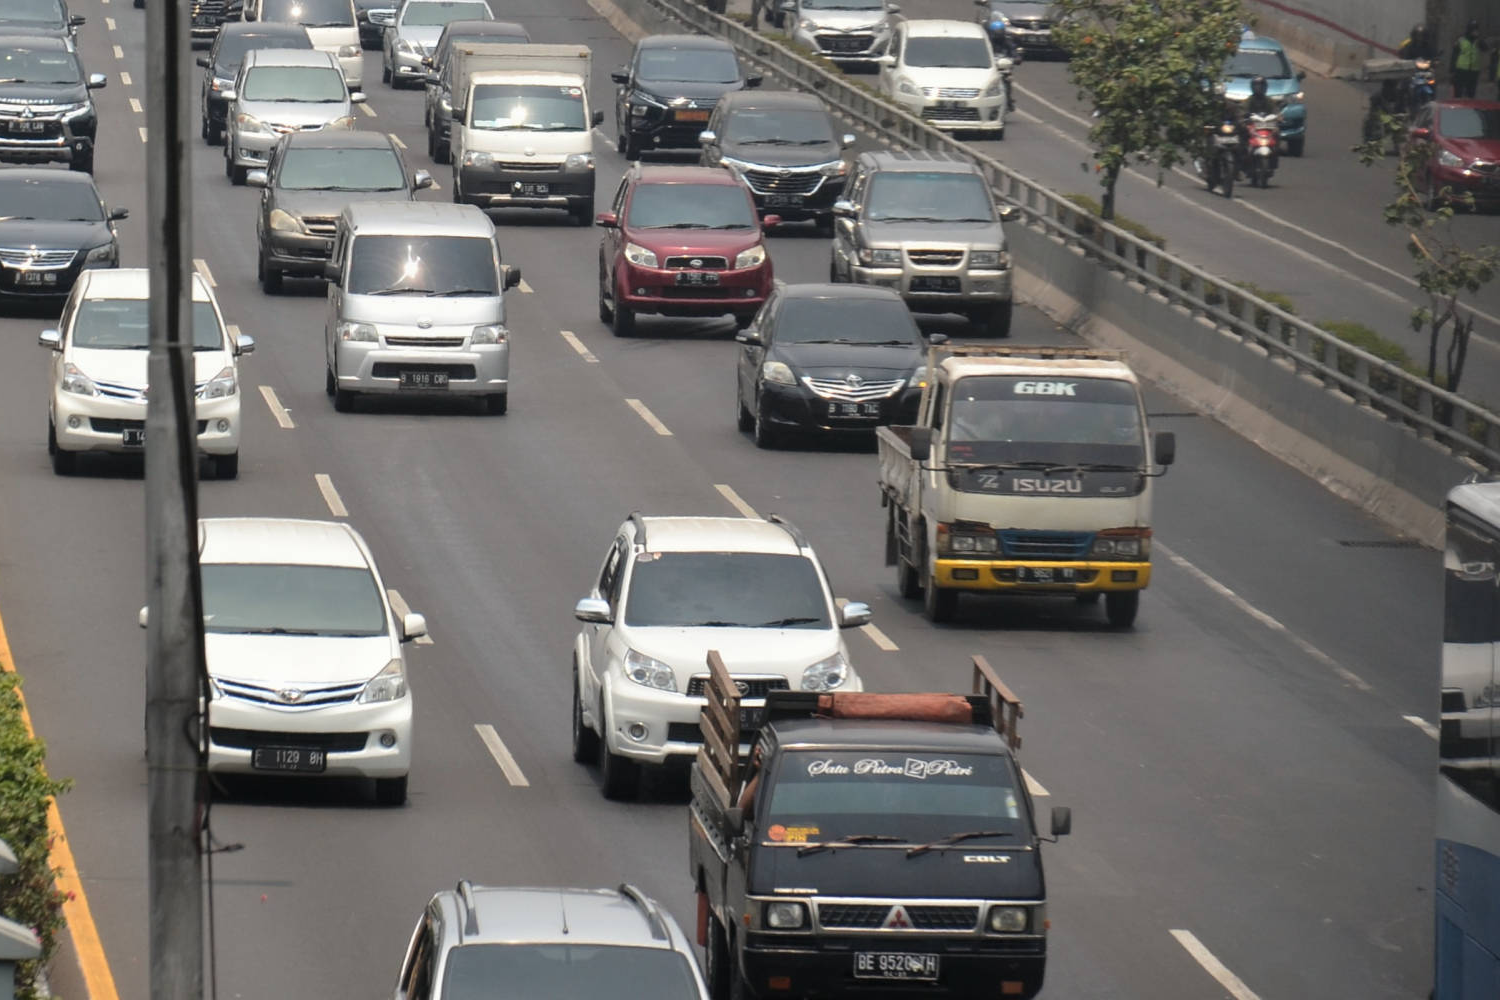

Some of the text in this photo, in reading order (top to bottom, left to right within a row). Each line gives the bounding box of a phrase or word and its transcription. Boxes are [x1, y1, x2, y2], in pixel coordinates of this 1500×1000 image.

[1013, 381, 1079, 397] GBK
[1013, 478, 1082, 493] ISUZU
[807, 759, 849, 777] Satu
[854, 758, 904, 775] Putra
[926, 760, 973, 776] Putri
[963, 855, 1011, 863] COLT
[858, 954, 874, 970] BE
